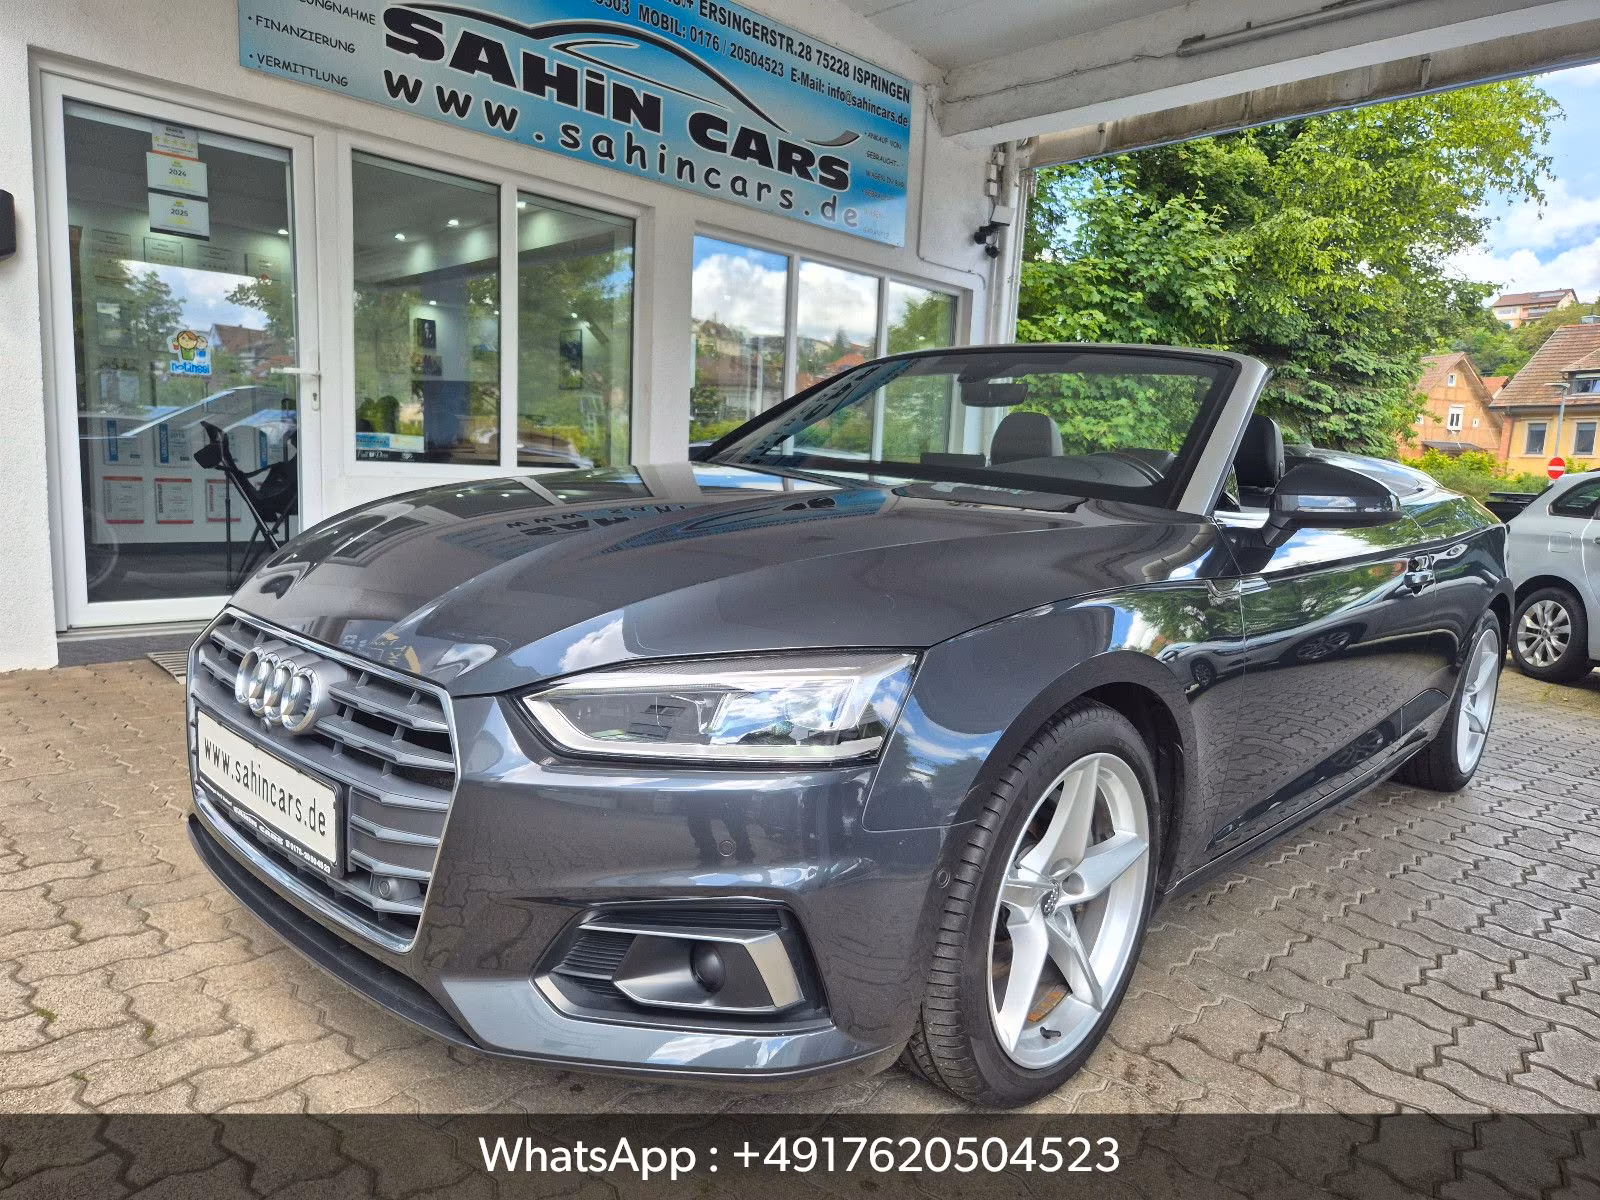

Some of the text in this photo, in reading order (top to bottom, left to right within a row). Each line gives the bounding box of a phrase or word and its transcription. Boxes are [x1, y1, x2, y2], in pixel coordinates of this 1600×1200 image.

[255, 15, 356, 54] FINANZIERUNG
[256, 53, 349, 87] VERMITTLUNG
[638, 4, 686, 39] MOBIL:
[690, 26, 720, 52] 0176
[730, 42, 785, 77] 20504523
[790, 71, 825, 94] E-Mail:
[827, 82, 909, 128] info@sahincars.de
[816, 46, 850, 78] 75228
[853, 64, 911, 104] ISPRINGEN
[168, 168, 187, 177] 2024
[689, 113, 849, 191] CARS
[170, 208, 189, 217] 2025
[204, 737, 326, 836] www.sahincars.de
